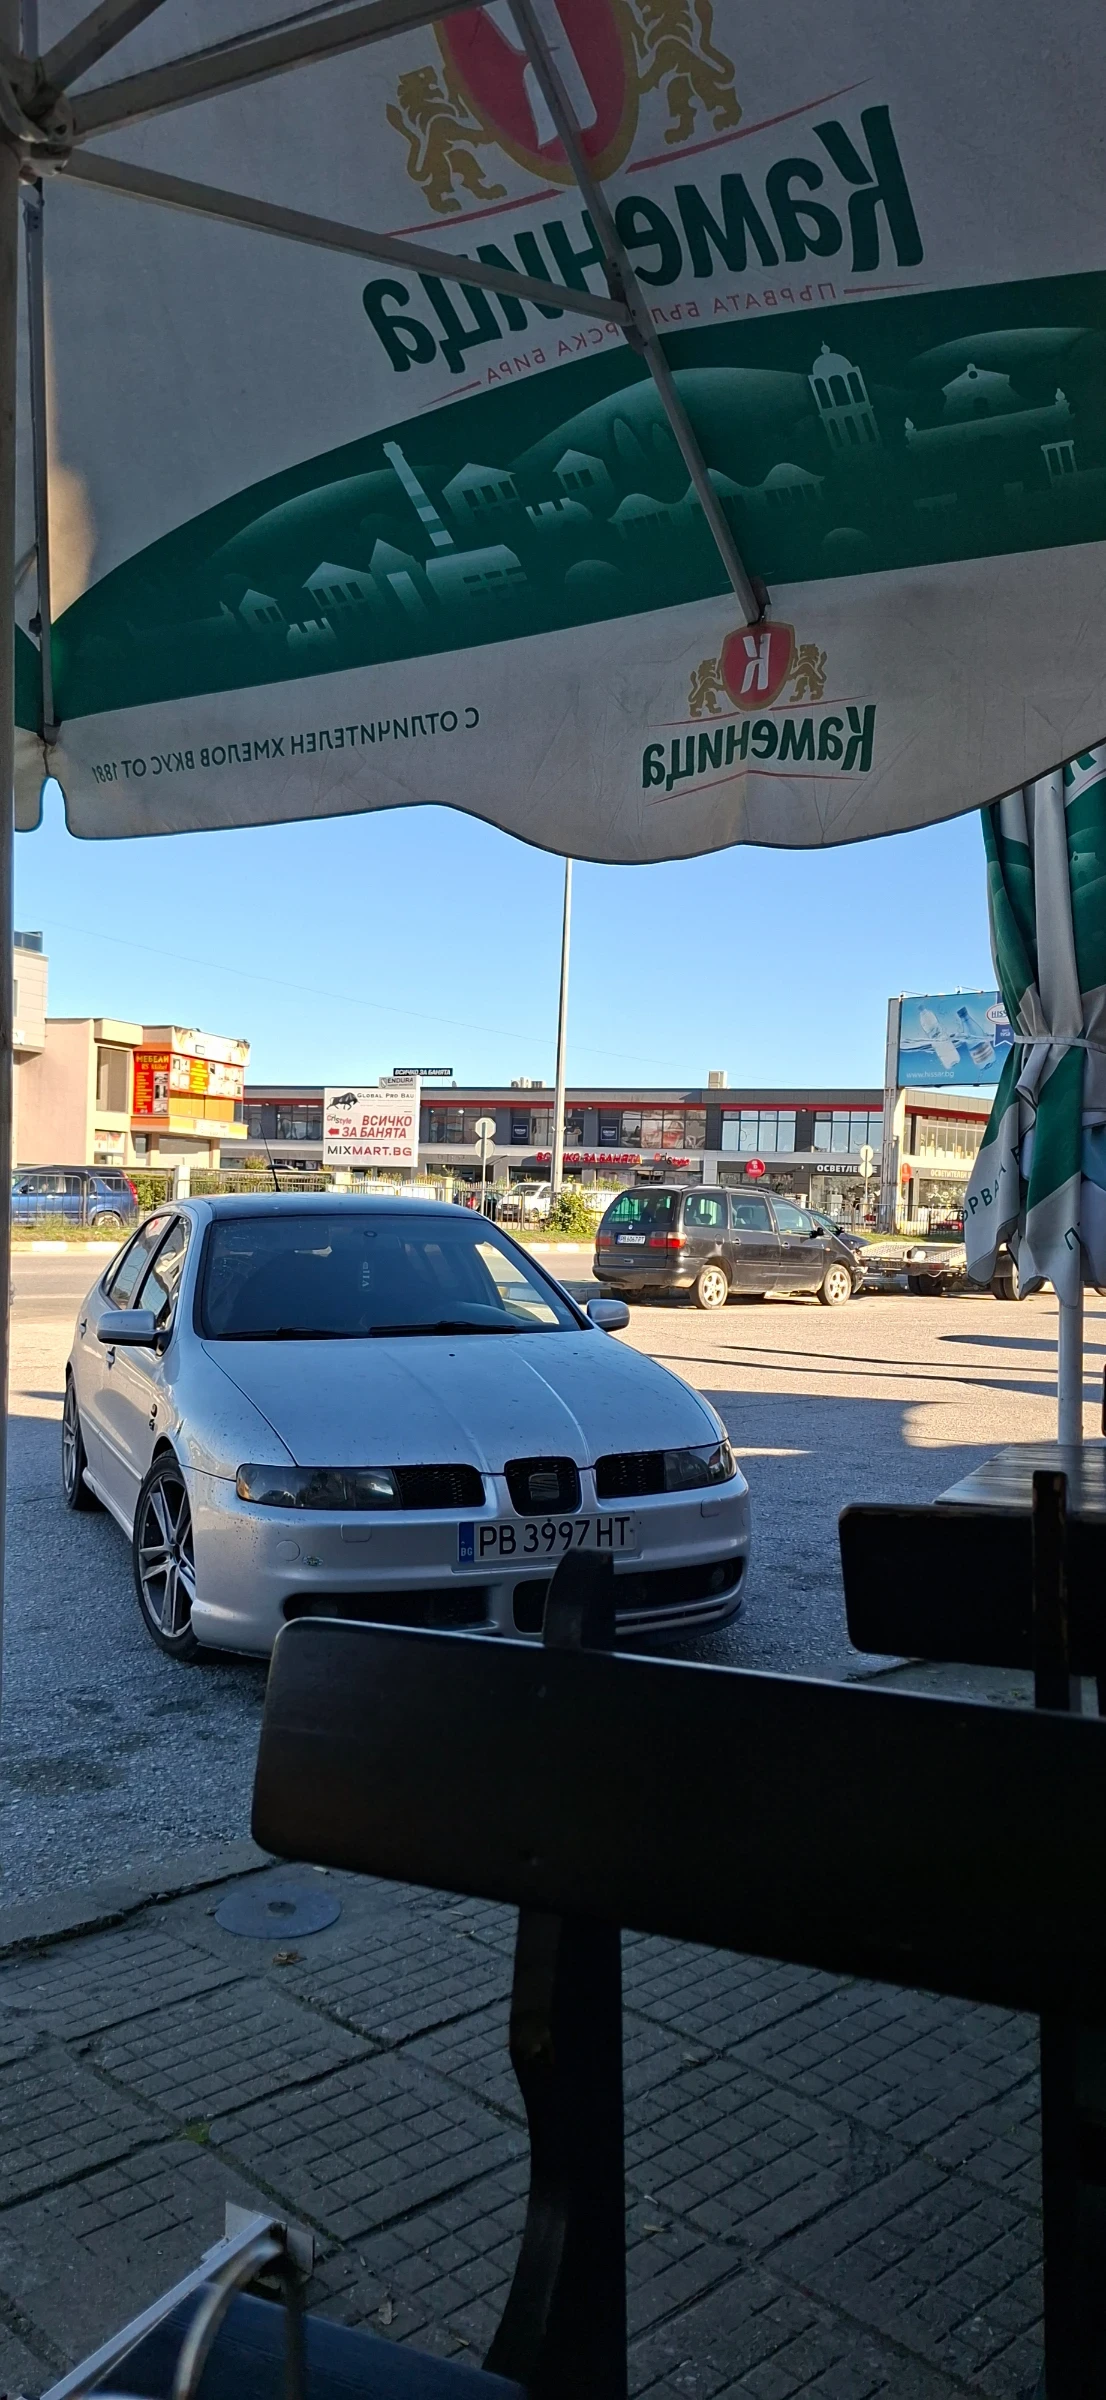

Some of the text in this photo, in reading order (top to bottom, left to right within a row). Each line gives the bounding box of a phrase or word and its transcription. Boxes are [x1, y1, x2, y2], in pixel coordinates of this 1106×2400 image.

[135, 1055, 169, 1063] МЕБЕЛИ
[906, 1071, 955, 1079] www.hissar.bg
[362, 1115, 412, 1127] ВСИЧКО
[342, 1127, 407, 1139] ЗА БАНЯТА
[327, 1145, 412, 1157] MIXMART.BG
[583, 1153, 598, 1163] ЗА
[599, 1153, 642, 1164] БАНЯТА
[479, 1516, 631, 1557] PB 3997 HT
[460, 1547, 473, 1557] BG
